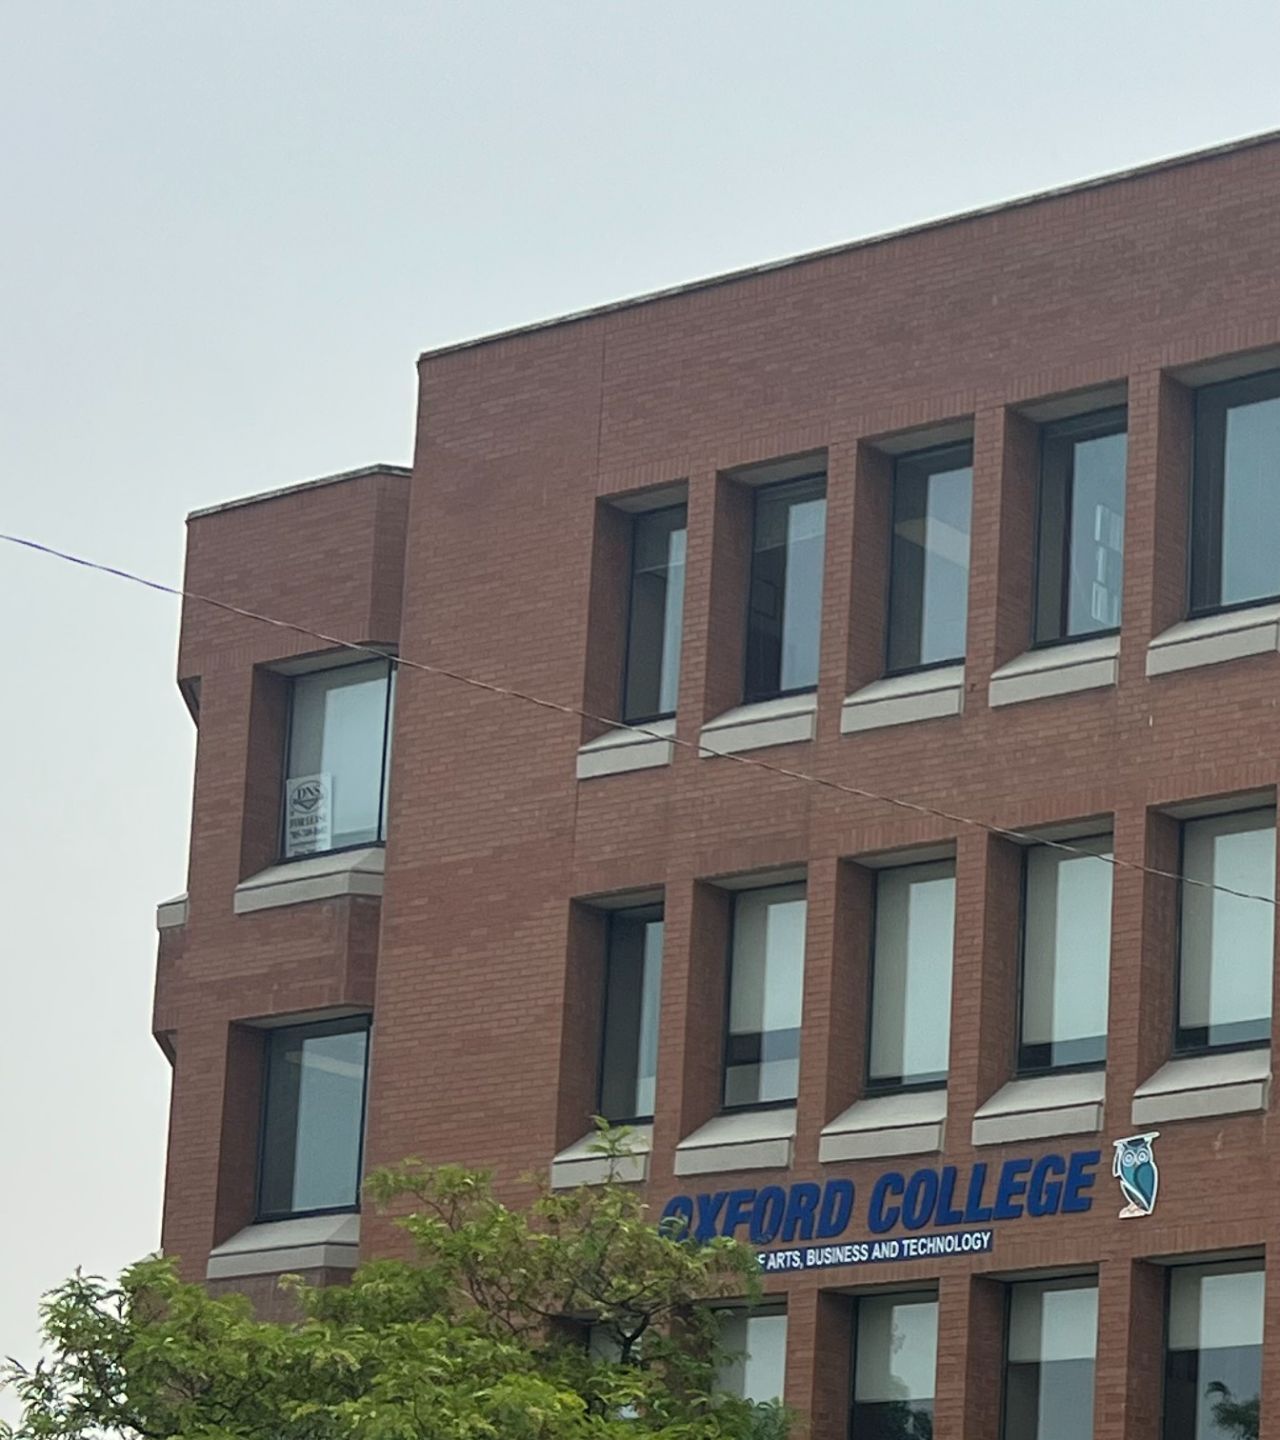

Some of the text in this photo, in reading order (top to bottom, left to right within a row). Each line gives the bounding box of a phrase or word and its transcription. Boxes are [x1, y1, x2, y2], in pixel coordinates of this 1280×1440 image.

[657, 1149, 1101, 1246] OXFORD COLLEGE
[766, 1251, 803, 1270] ARTS,
[806, 1245, 868, 1266] BUSINESS
[871, 1240, 899, 1260] AND
[902, 1231, 991, 1256] TECHNOLOGY
